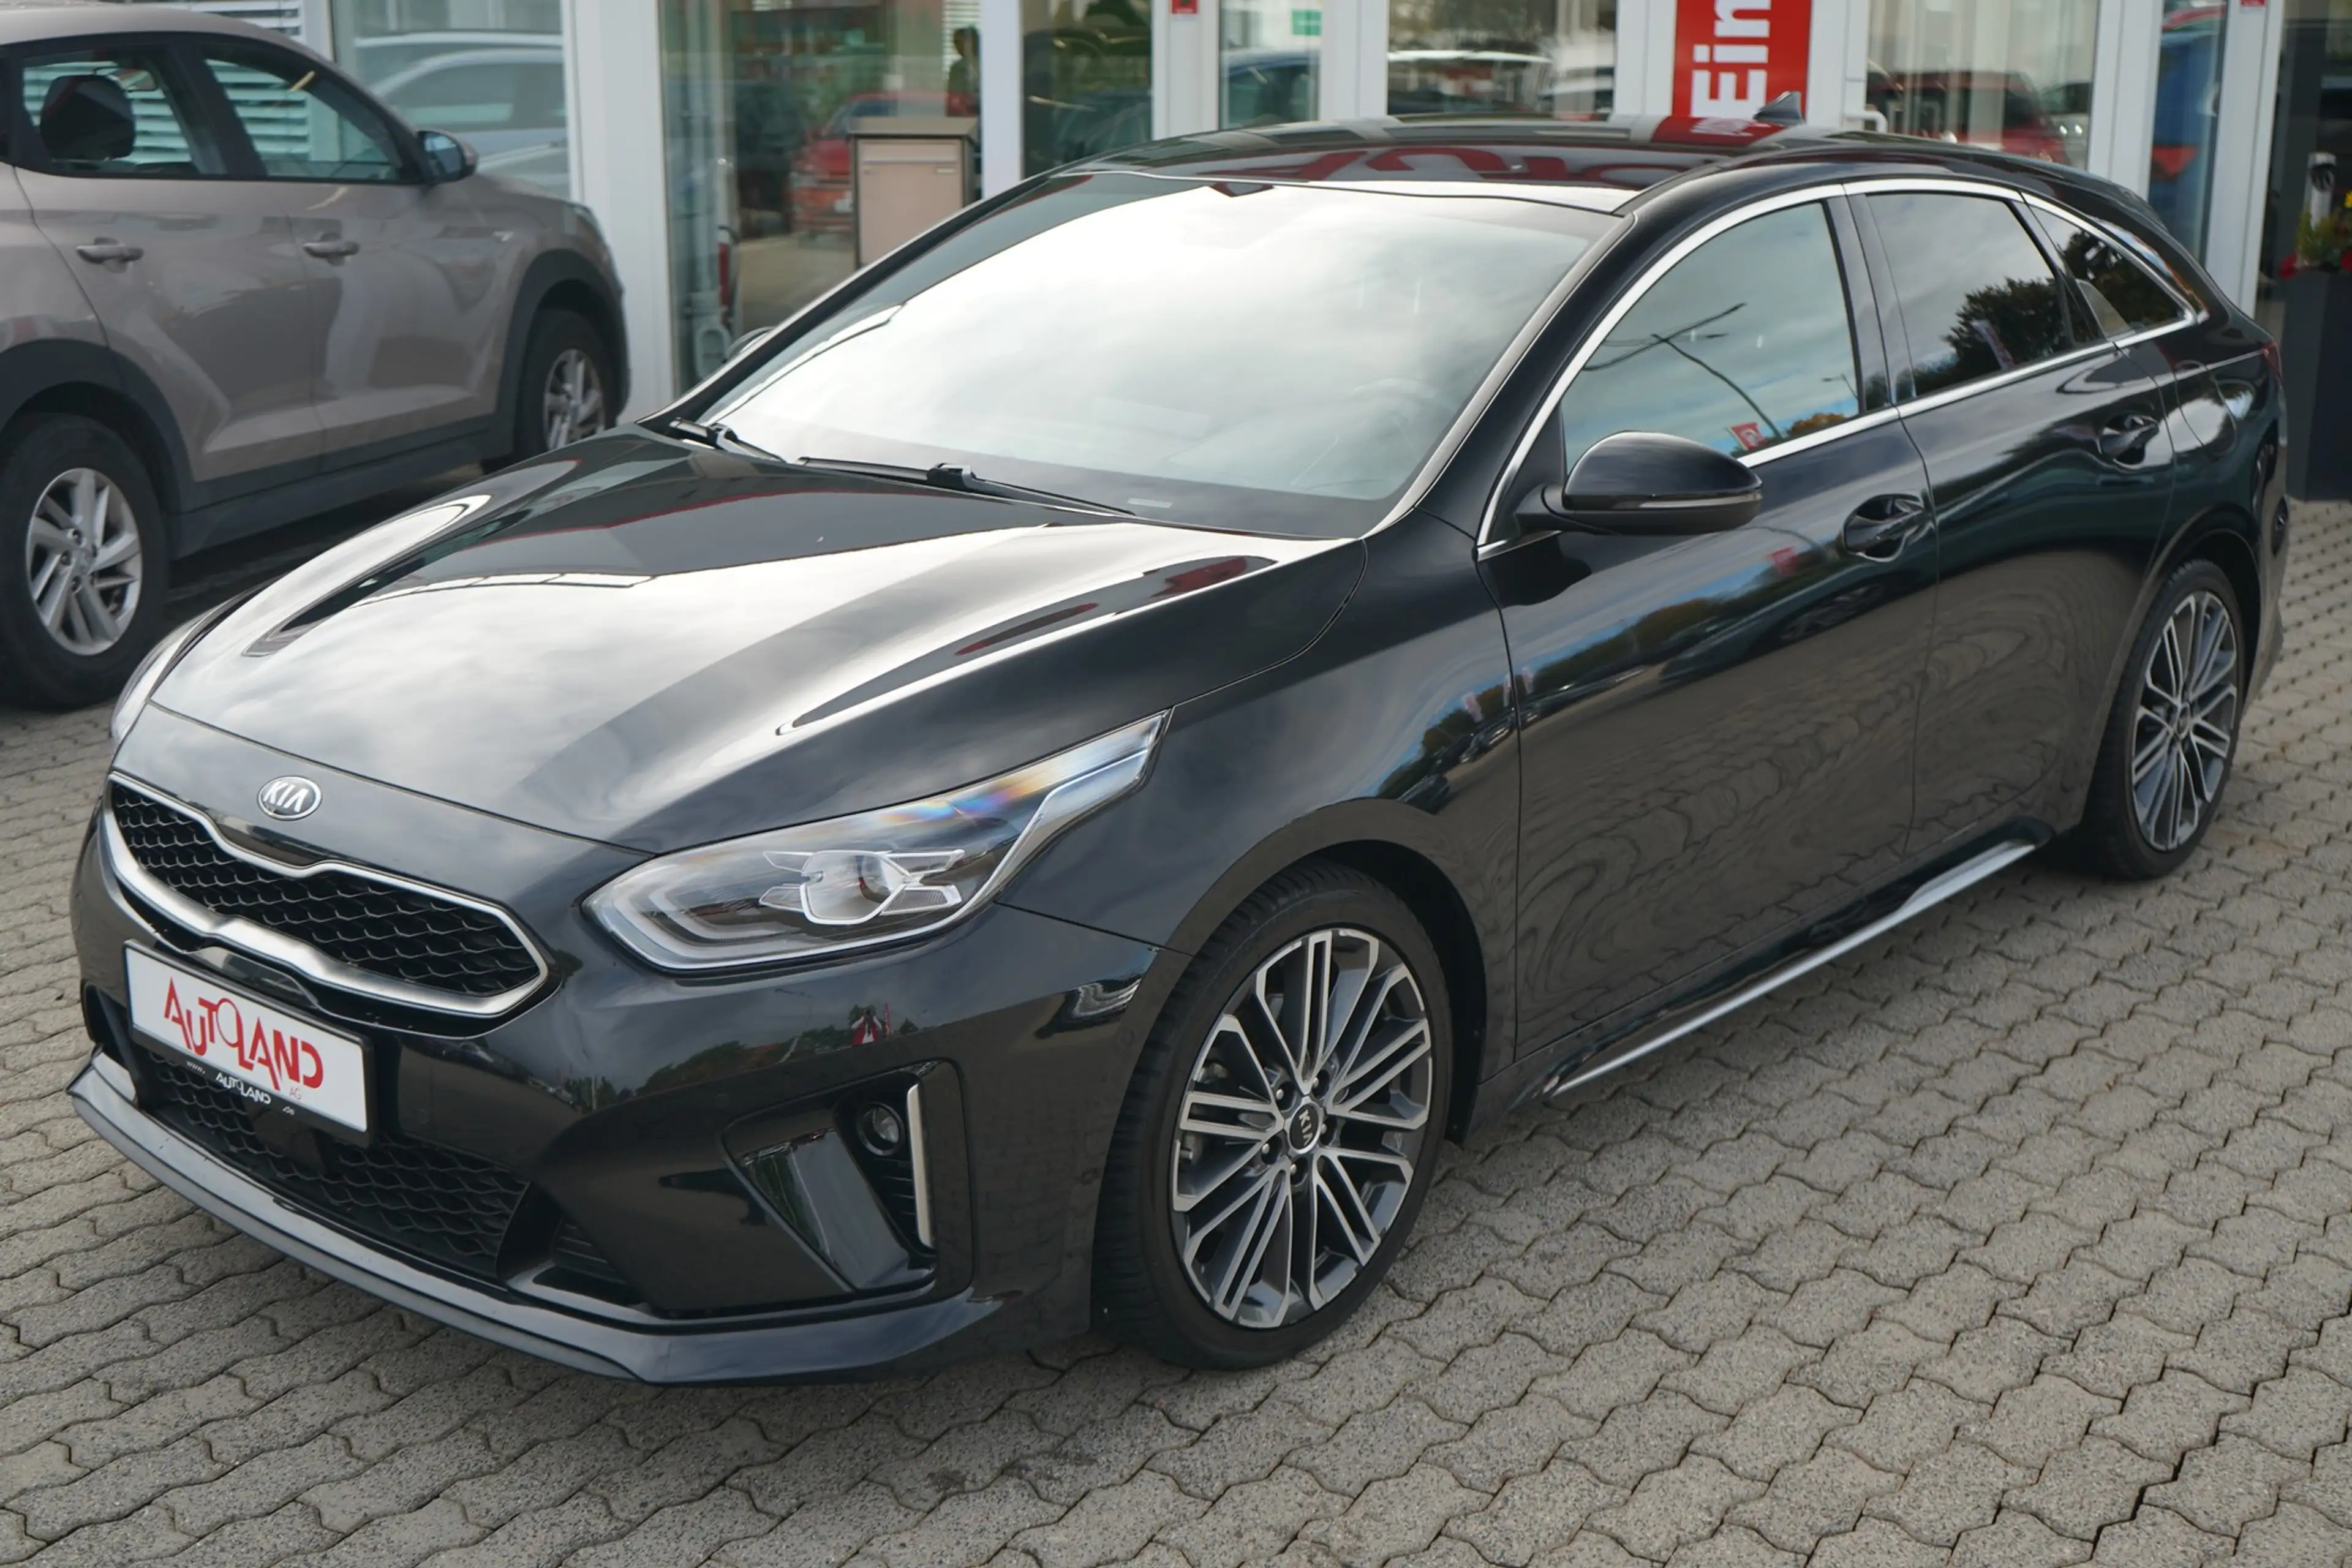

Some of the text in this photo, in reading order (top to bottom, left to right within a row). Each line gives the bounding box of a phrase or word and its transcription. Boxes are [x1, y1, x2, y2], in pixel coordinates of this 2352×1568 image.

[263, 781, 309, 812] KIA
[164, 977, 323, 1091] AUTOLAND
[215, 1072, 271, 1104] AUTOLAND
[1298, 1109, 1313, 1147] KIA
